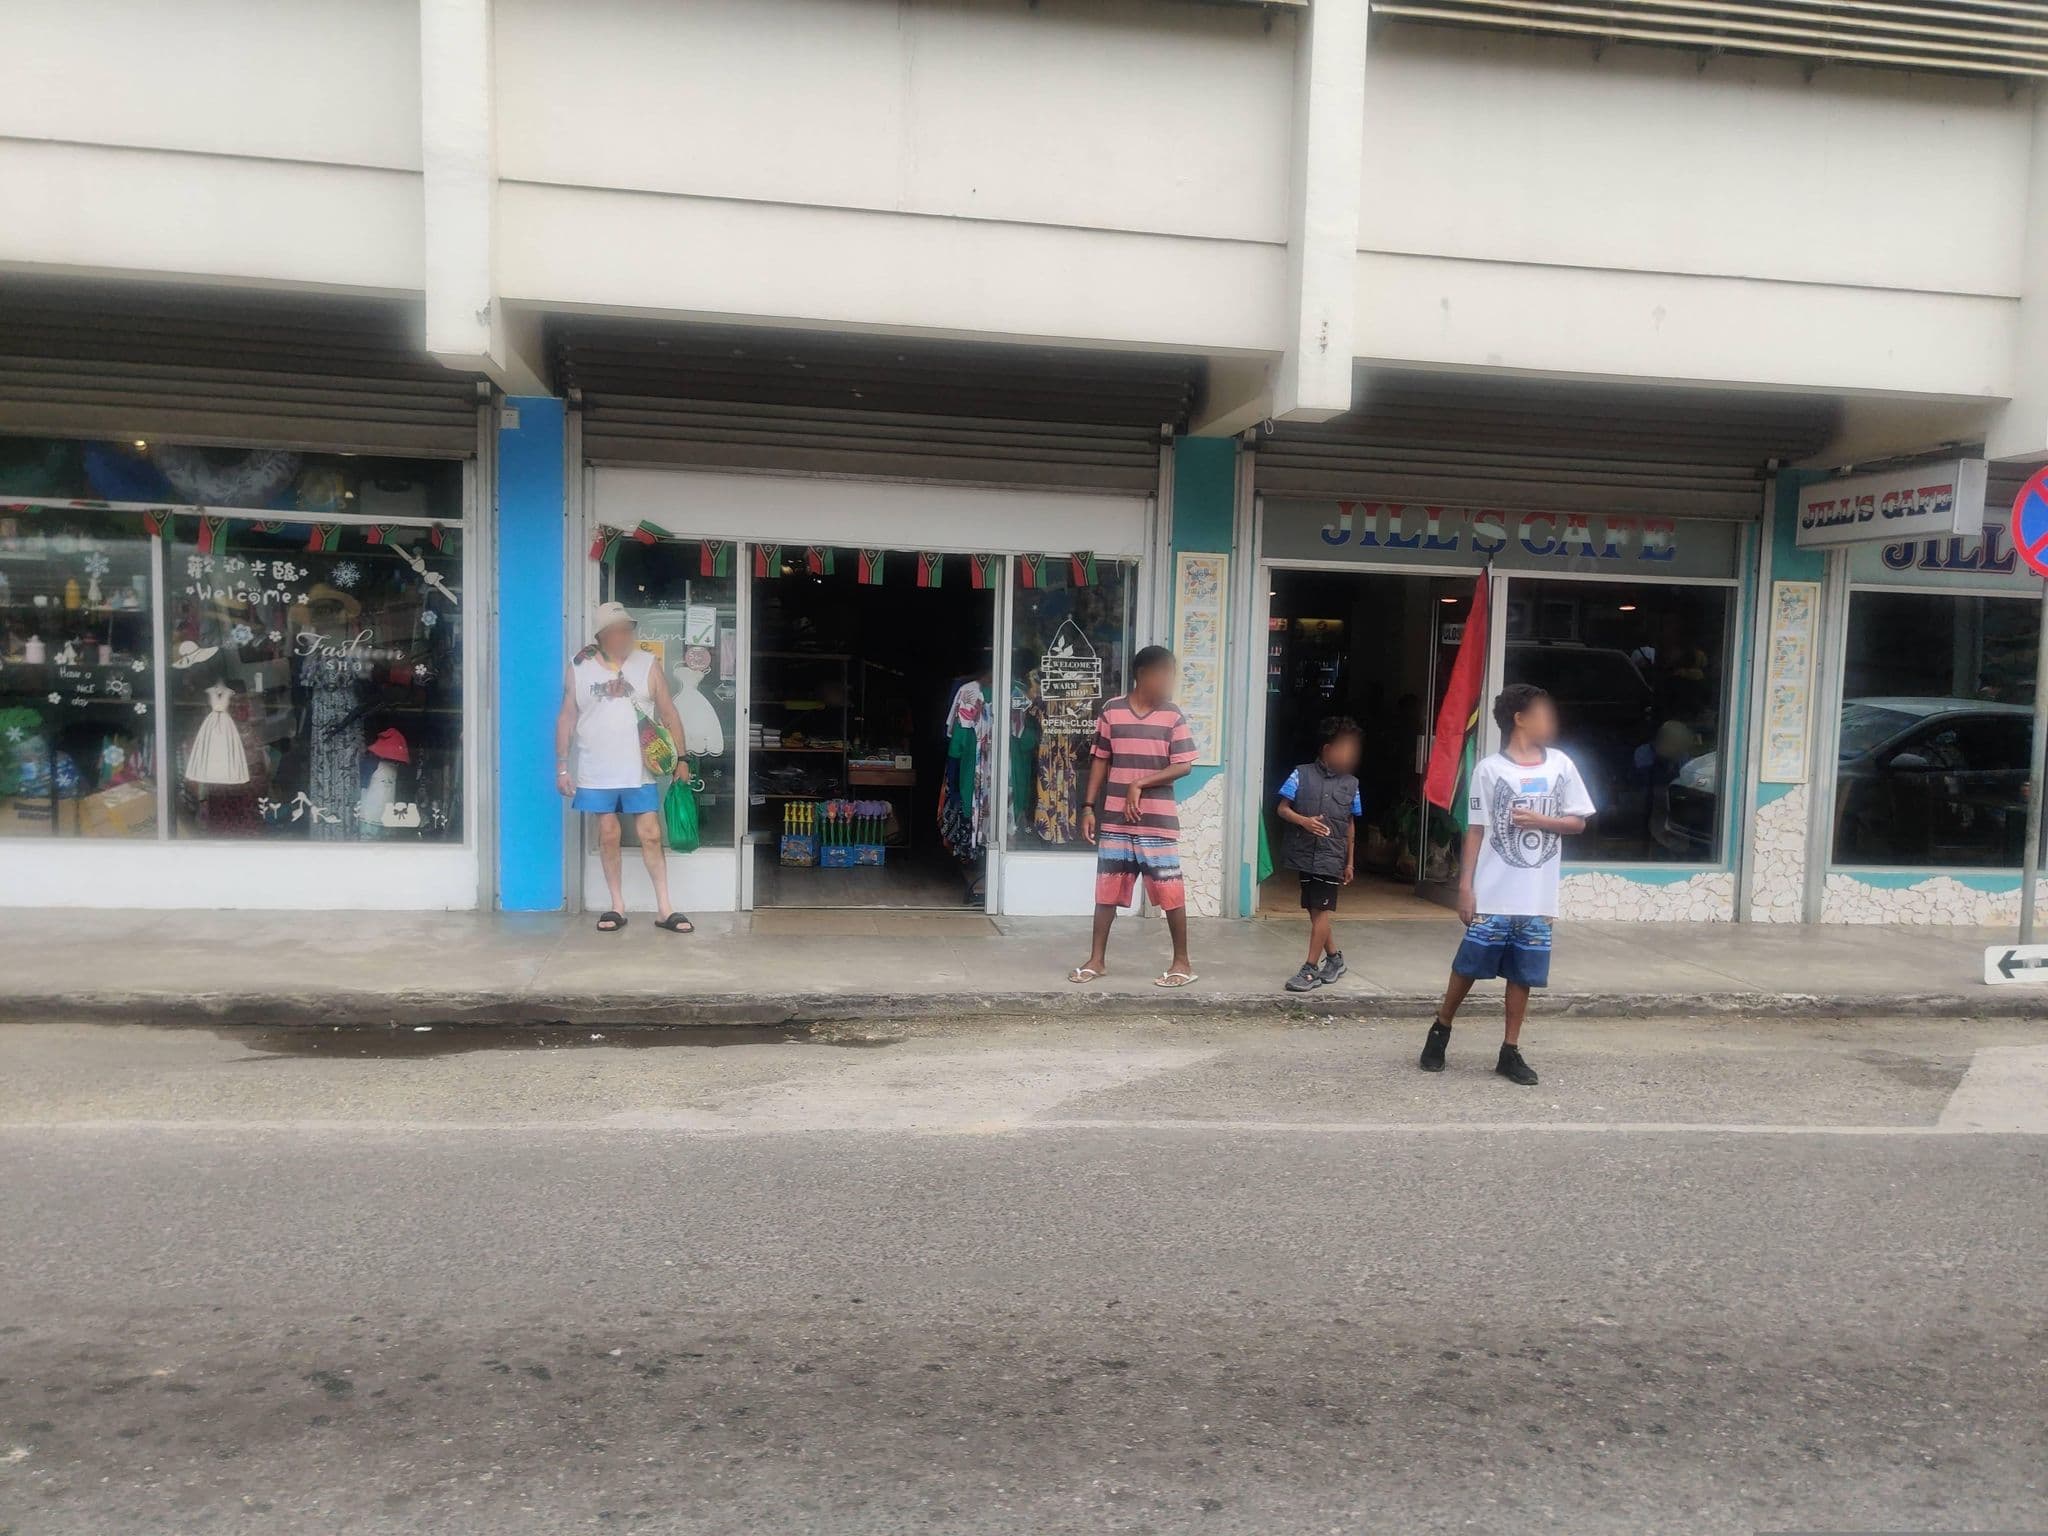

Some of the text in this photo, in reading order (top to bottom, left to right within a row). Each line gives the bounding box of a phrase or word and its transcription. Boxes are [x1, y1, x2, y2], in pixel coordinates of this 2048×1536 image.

[1802, 484, 1953, 529] JILL'S CAFE
[1321, 500, 1676, 561] JILL'S CAFE
[1053, 661, 1091, 669] WELCOME
[1052, 682, 1077, 690] WARM
[1065, 689, 1090, 698] SHOP
